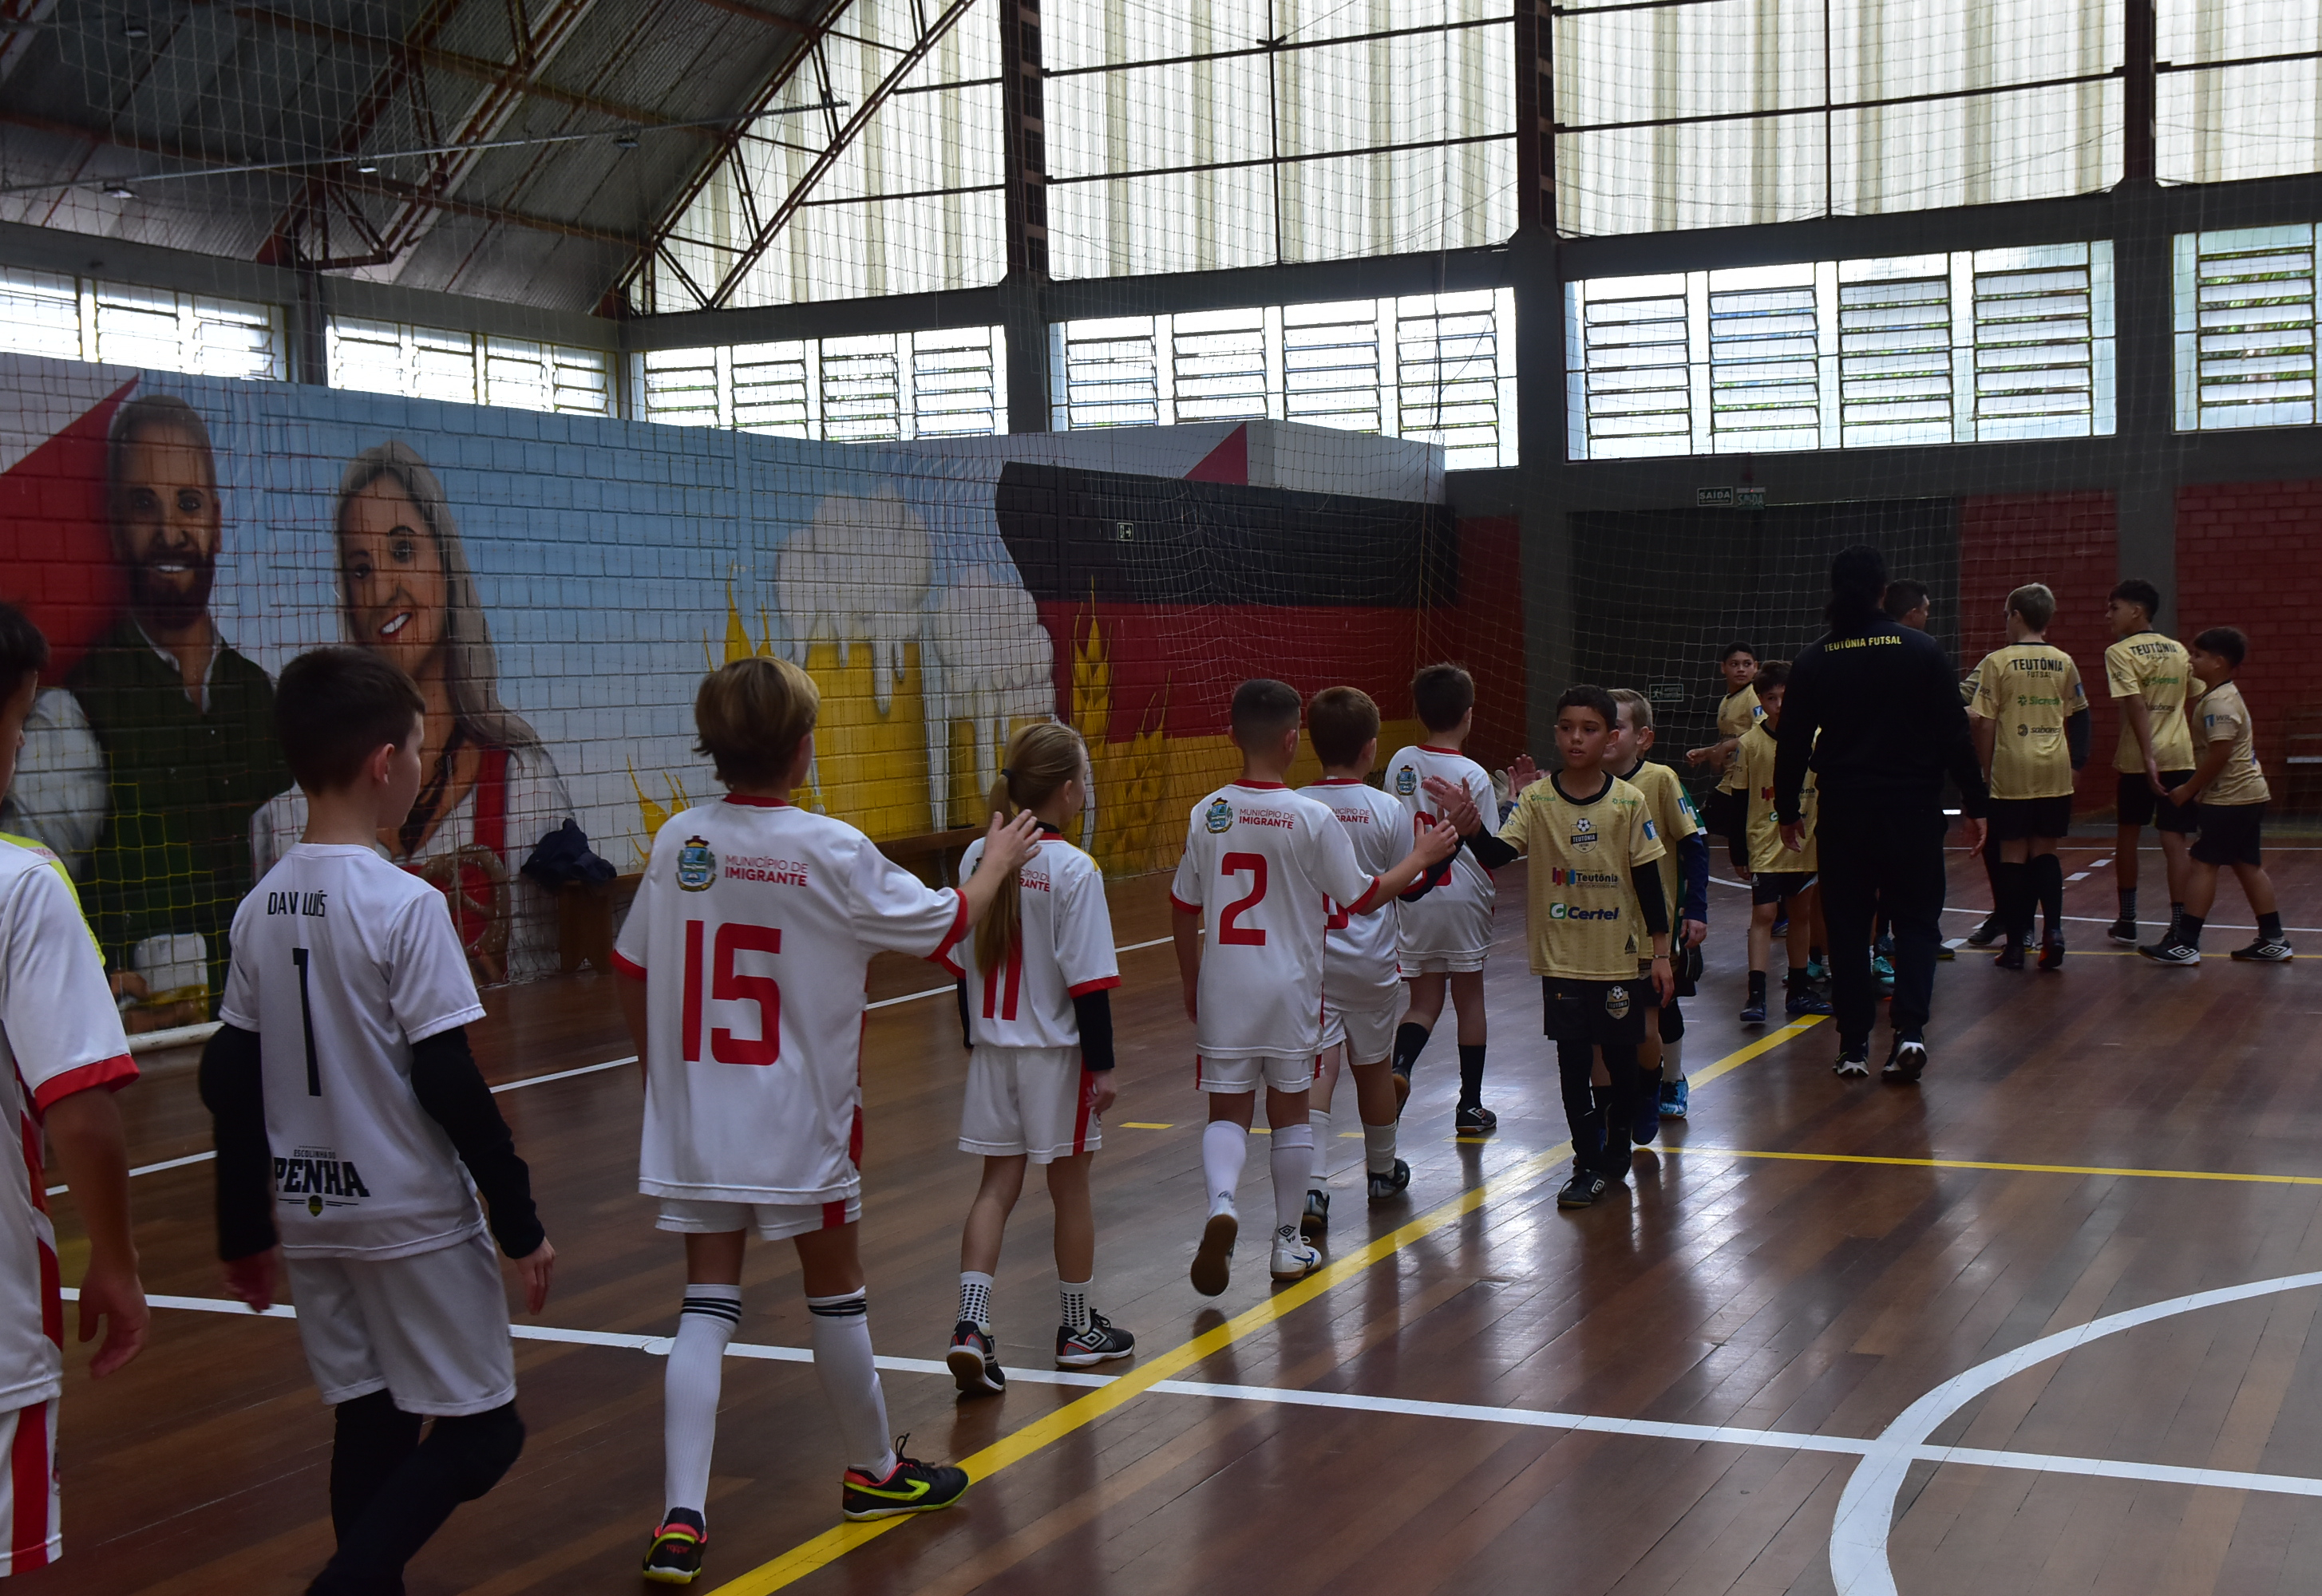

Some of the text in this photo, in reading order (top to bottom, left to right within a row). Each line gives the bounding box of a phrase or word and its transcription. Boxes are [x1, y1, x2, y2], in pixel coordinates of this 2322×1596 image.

[1699, 490, 1731, 500] SAÍDA
[1824, 635, 1902, 652] TEUTÔNIA FUTSAL
[2011, 658, 2063, 672] TEUTÔNIA
[1239, 808, 1295, 821] MUNICÍPIO DE
[1332, 807, 1359, 816] NICÍPIO
[1239, 816, 1294, 830] IMIGRANTE
[1335, 814, 1370, 824] GRANTE
[725, 855, 809, 874] MUNICÍPIO DE
[725, 866, 808, 887] IMIGRANTE
[1576, 872, 1618, 883] Teutônia
[1019, 878, 1050, 892] RANTE
[302, 890, 328, 918] LUÍS
[1219, 852, 1268, 946] 2
[1568, 907, 1620, 920] Certel
[682, 920, 781, 1066] 15
[292, 948, 322, 1097] 1
[273, 1156, 370, 1198] PENHA
